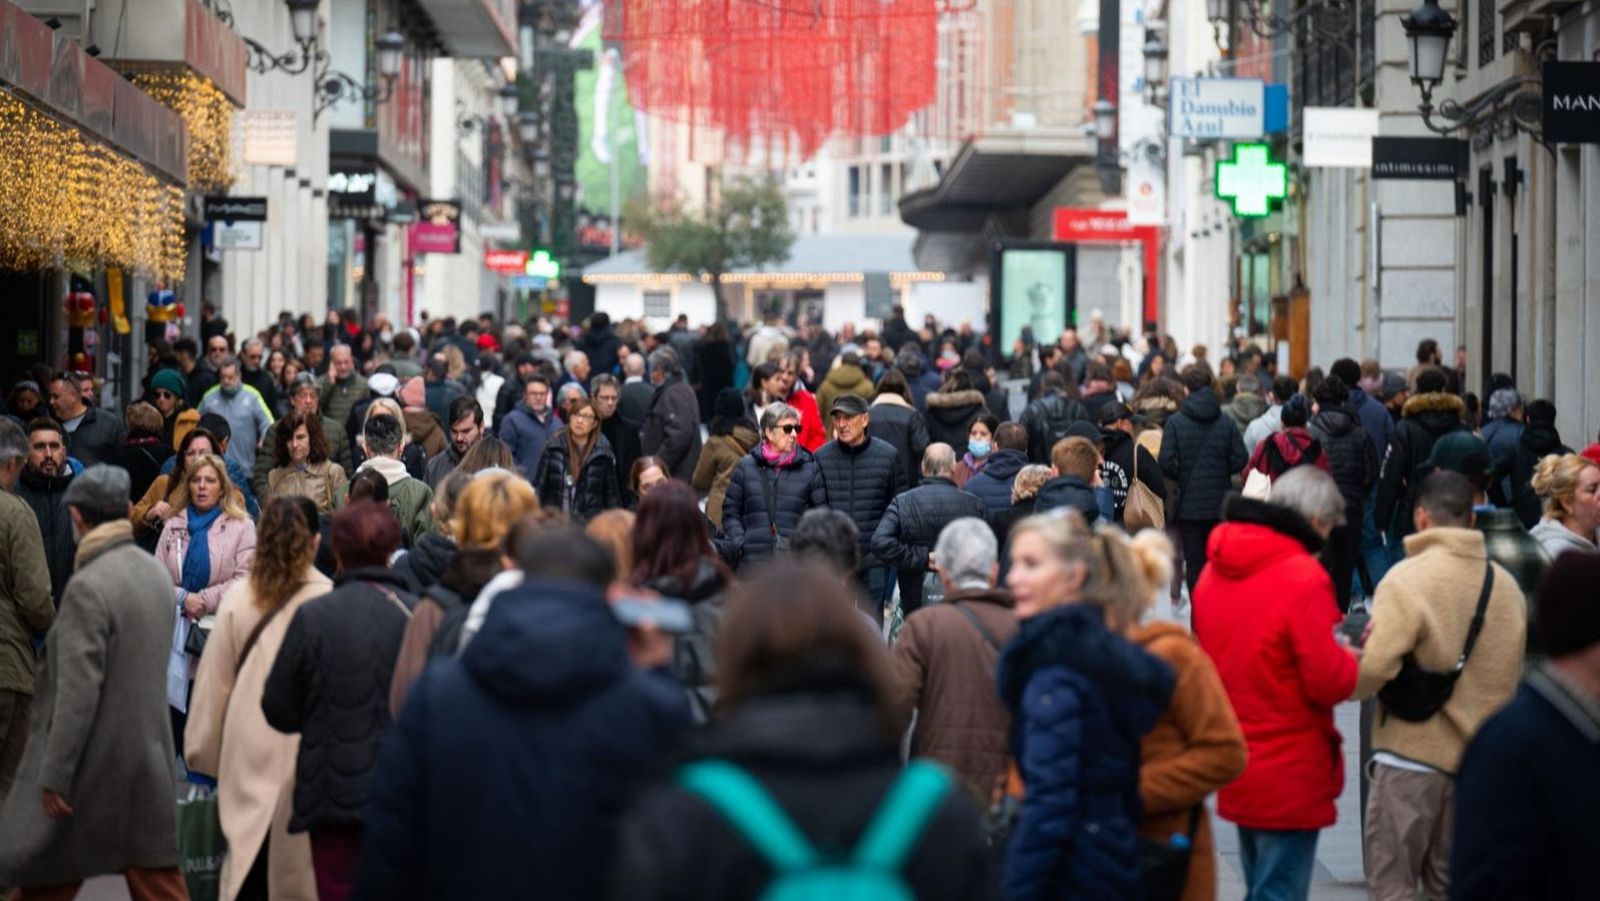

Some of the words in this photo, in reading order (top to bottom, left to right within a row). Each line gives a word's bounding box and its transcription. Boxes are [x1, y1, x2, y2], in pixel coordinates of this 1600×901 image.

[1181, 78, 1200, 96] El
[1181, 98, 1257, 115] Danubio
[1180, 117, 1224, 133] Azul
[1374, 160, 1455, 174] intimissimi
